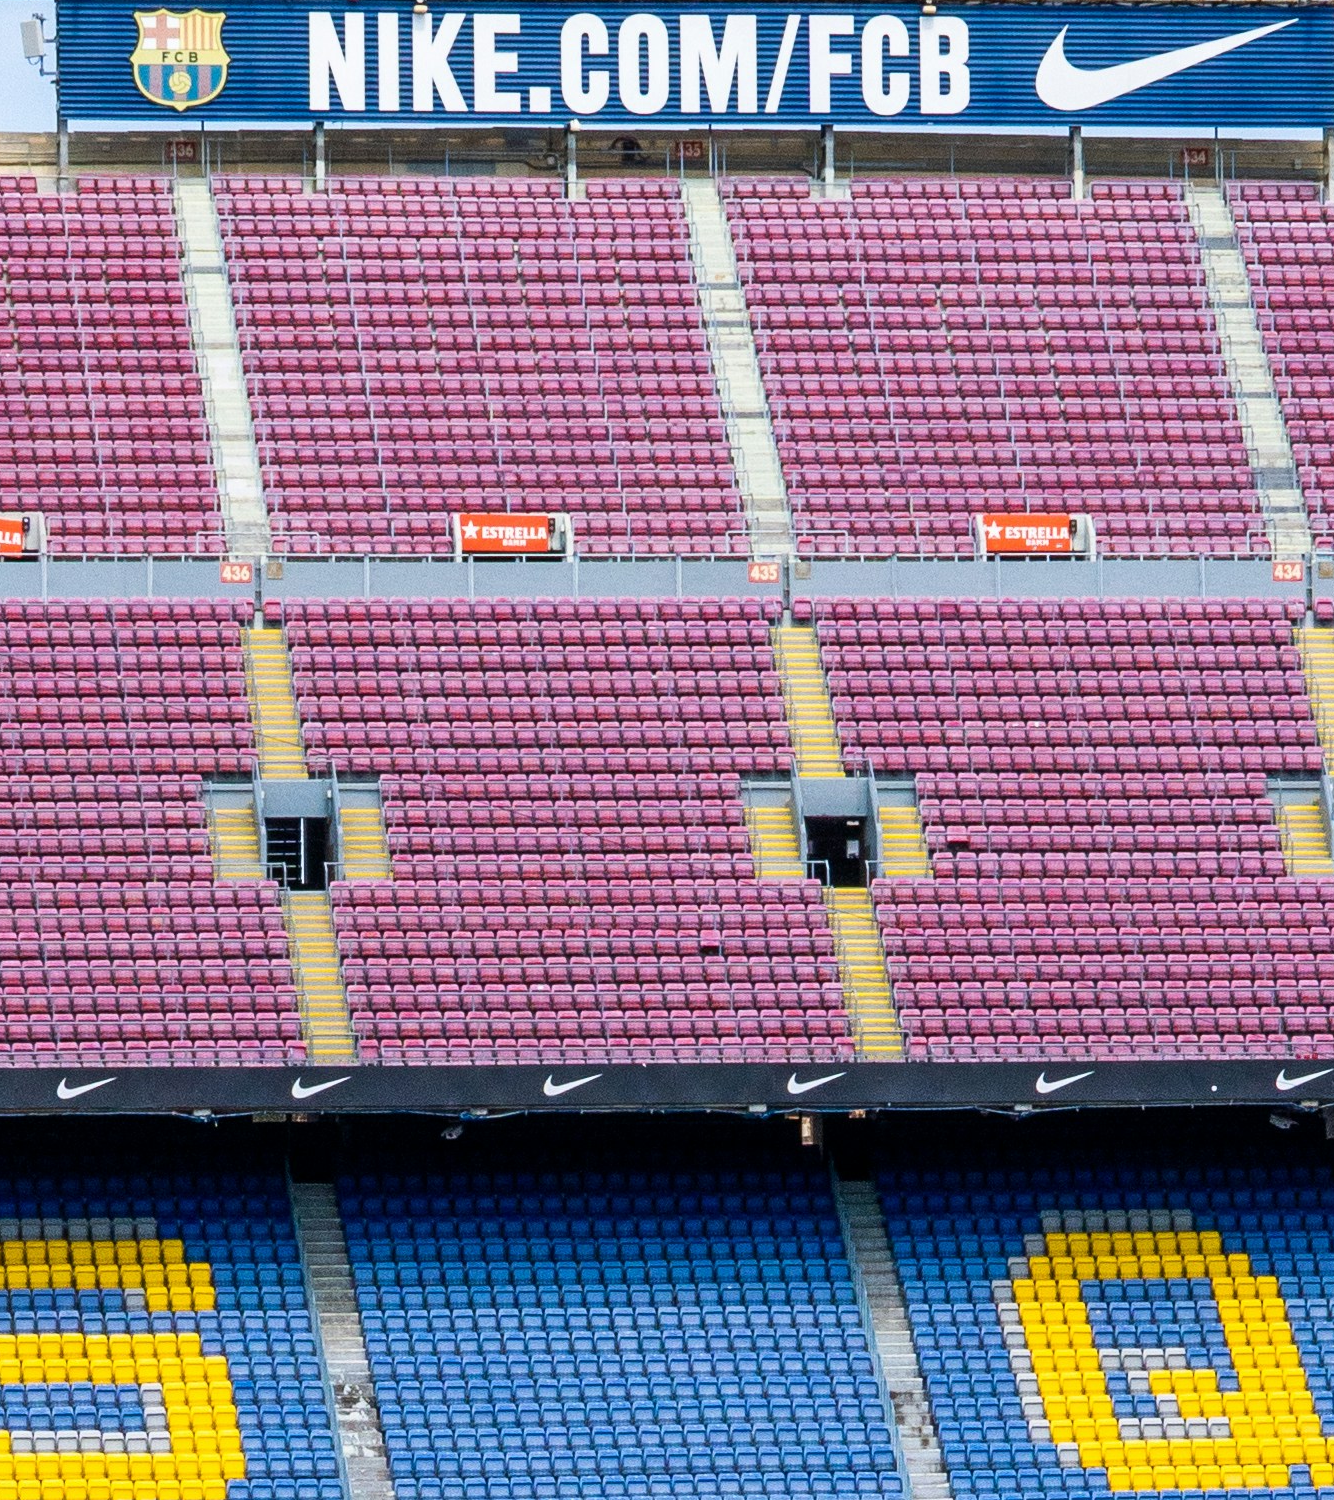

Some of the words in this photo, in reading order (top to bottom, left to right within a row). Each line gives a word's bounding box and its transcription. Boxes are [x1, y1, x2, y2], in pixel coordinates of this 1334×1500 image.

[162, 51, 199, 63] FCB
[309, 12, 971, 115] NIKE.COM/FCB
[482, 526, 547, 539] ESTRELLA
[1005, 526, 1068, 539] ESTRELLA
[222, 566, 250, 580] 436
[750, 565, 777, 580] 435
[1274, 564, 1302, 579] 434
